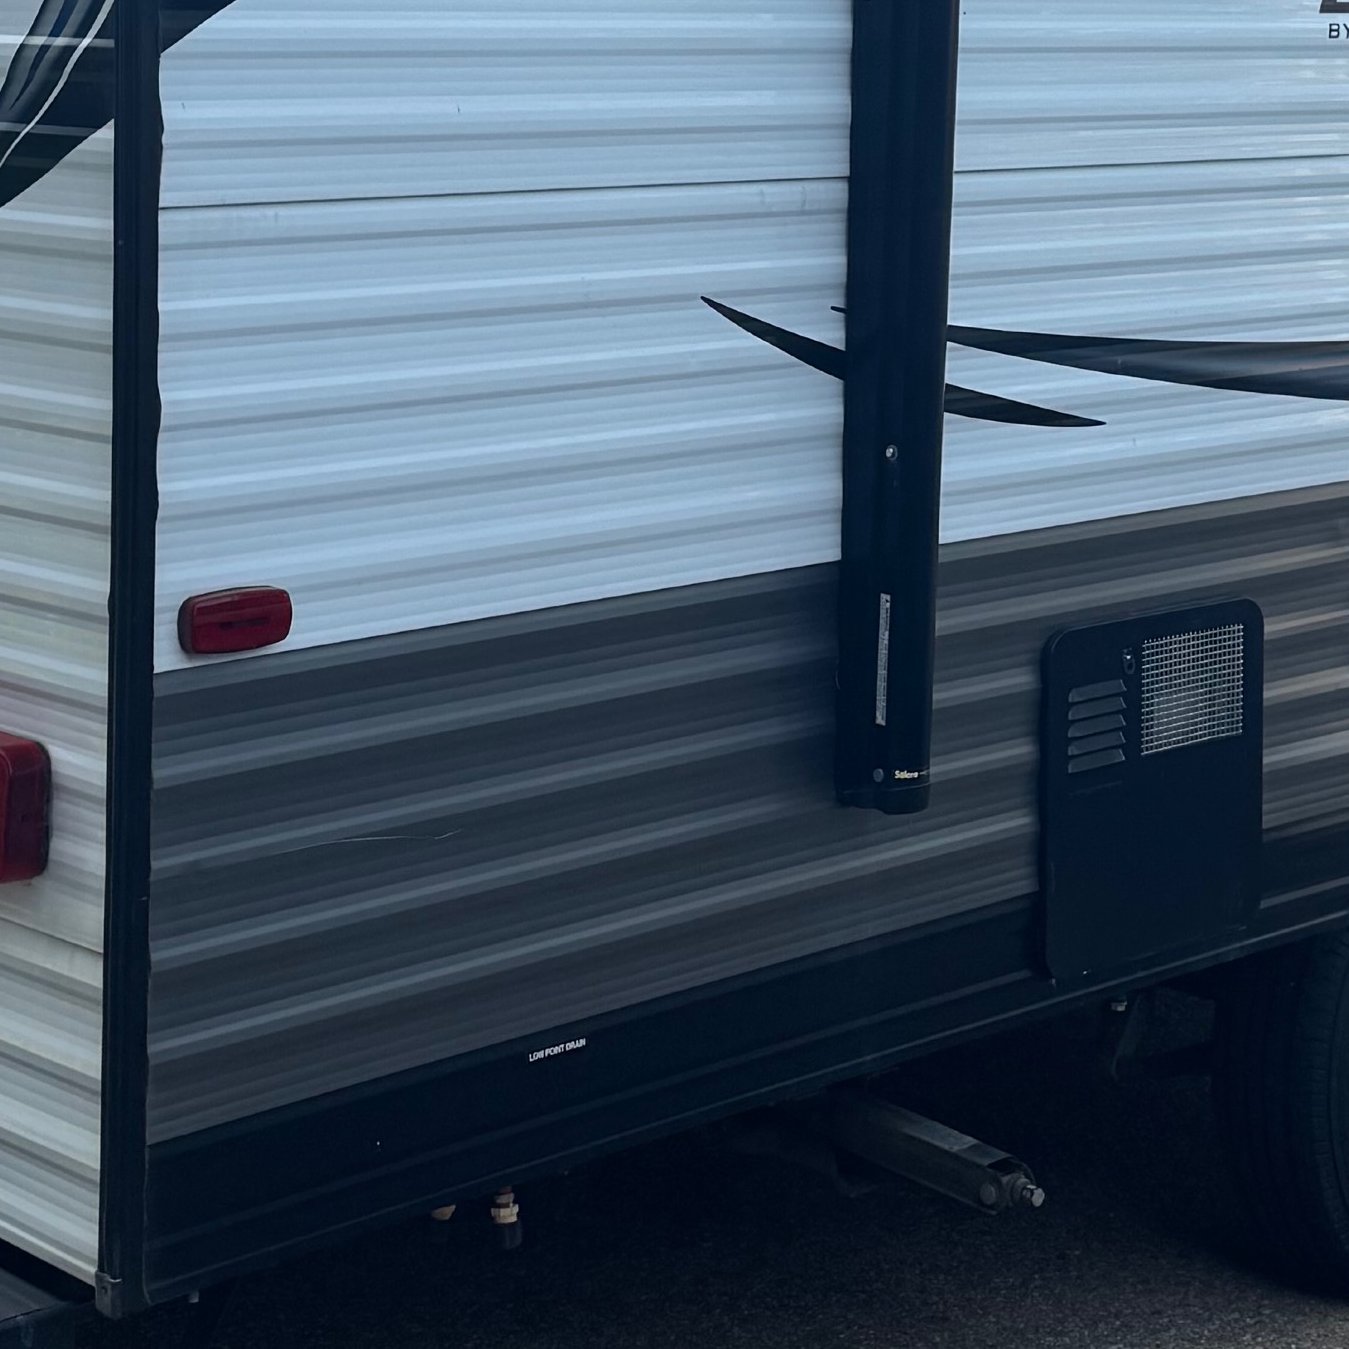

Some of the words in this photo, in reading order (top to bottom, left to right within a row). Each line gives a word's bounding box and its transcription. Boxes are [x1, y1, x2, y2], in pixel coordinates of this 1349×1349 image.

[528, 1049, 544, 1062] LOW
[545, 1044, 565, 1057] POINT
[565, 1038, 586, 1051] DRAIN
